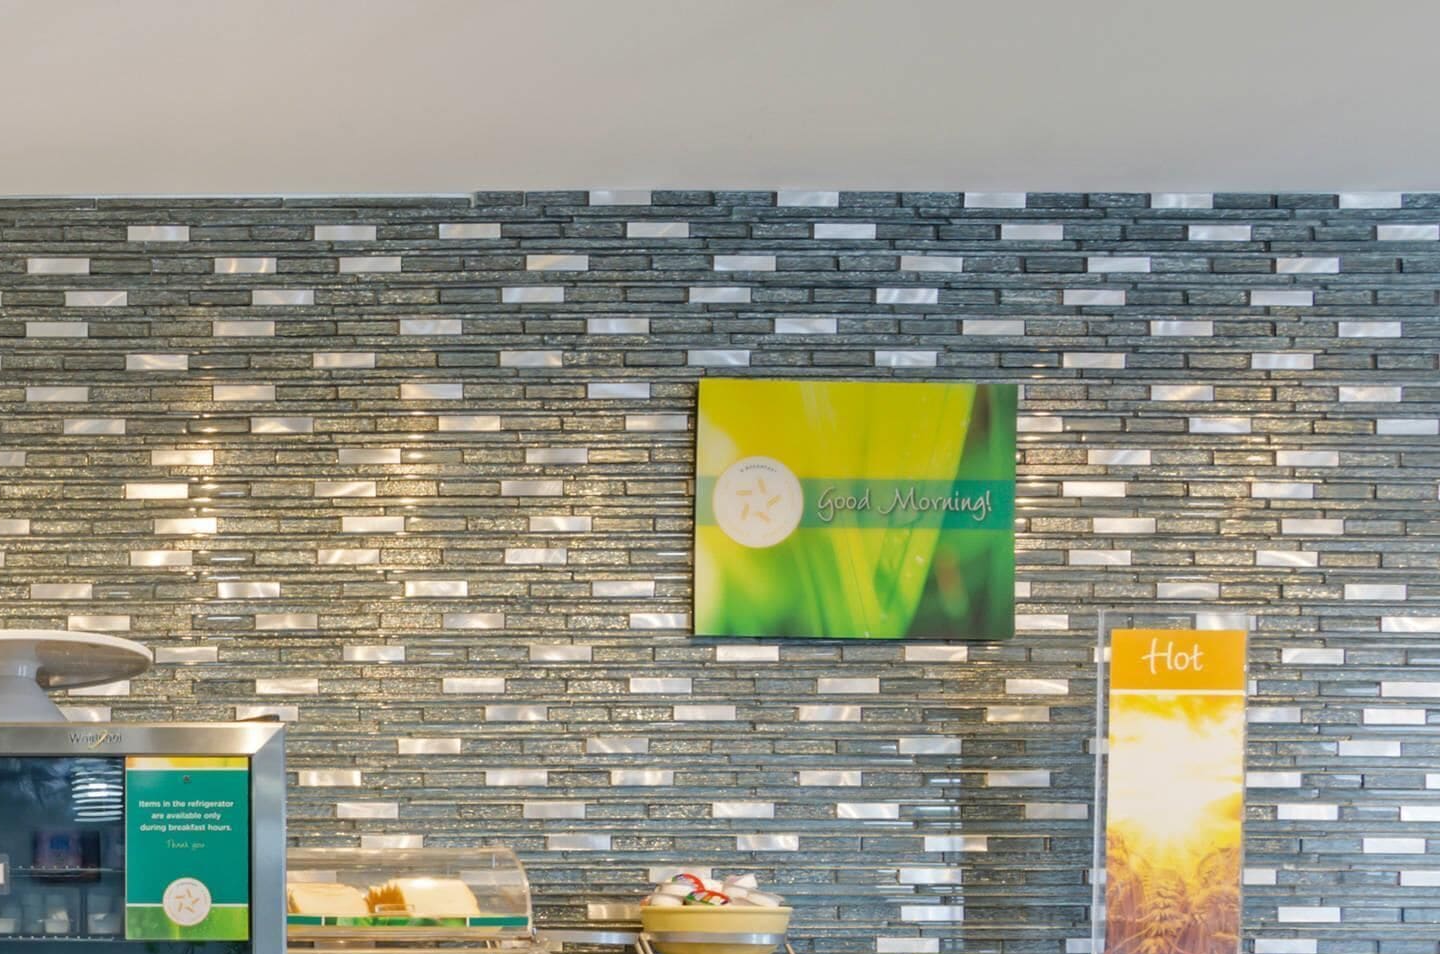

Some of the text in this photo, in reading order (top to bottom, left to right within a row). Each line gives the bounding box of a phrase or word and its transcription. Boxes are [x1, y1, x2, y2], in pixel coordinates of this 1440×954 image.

[817, 486, 992, 522] Good Morning!
[1142, 638, 1205, 675] Hot
[139, 800, 234, 809] Items in the refrigerator
[203, 812, 221, 821] only
[140, 824, 166, 832] during
[166, 839, 189, 849] Thank
